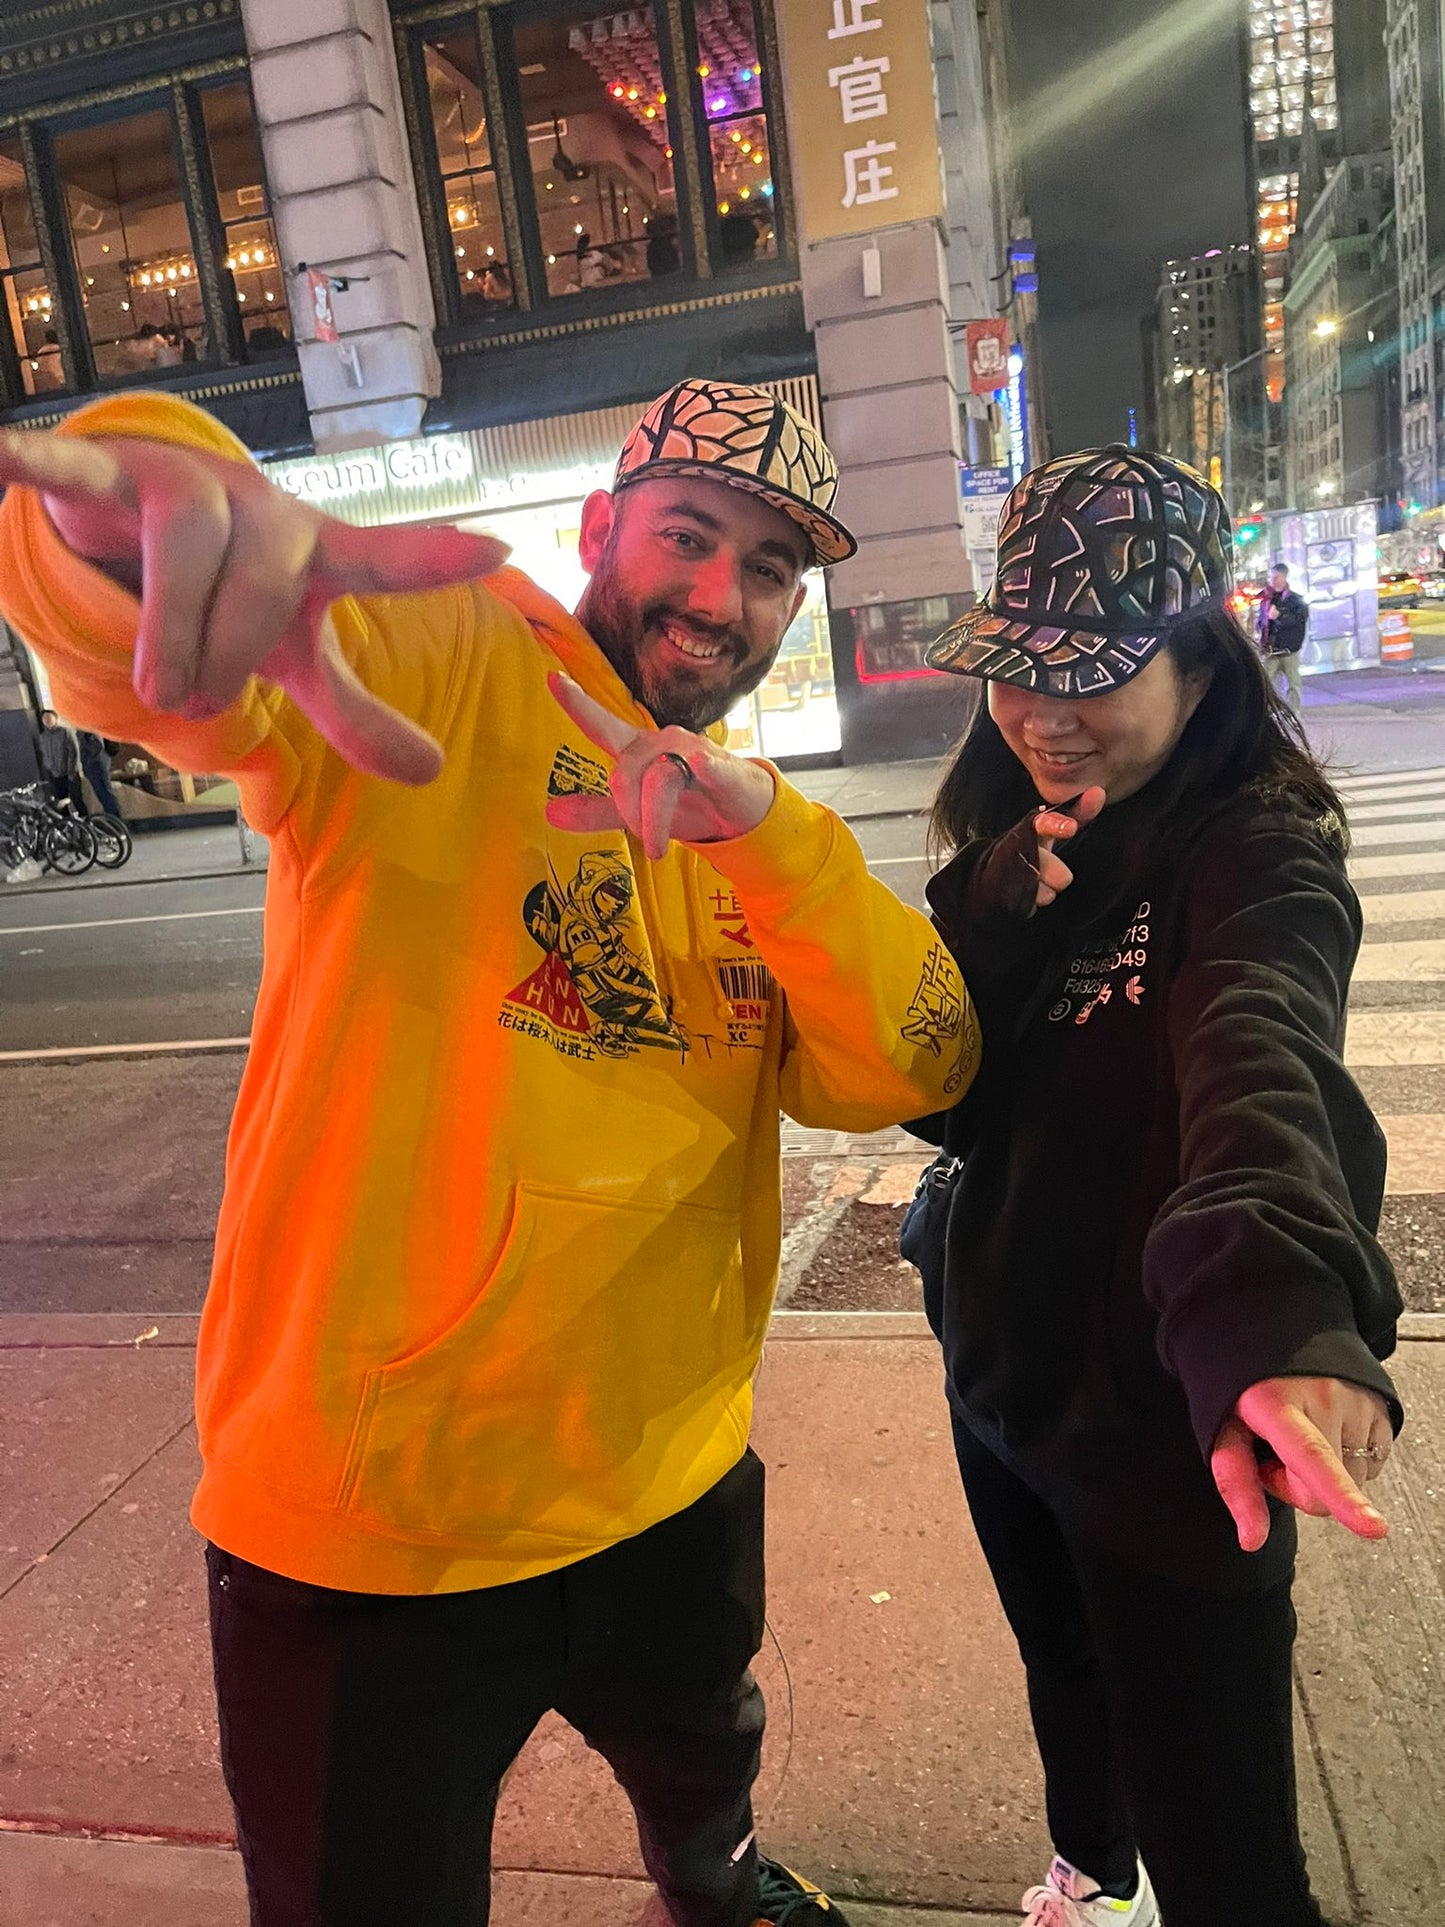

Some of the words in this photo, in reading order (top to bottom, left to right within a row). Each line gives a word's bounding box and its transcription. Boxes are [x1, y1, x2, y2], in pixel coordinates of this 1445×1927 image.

[973, 470, 1001, 479] OFFICE
[965, 478, 991, 488] SPACE
[993, 477, 1010, 485] FOR
[977, 486, 999, 494] RENT
[731, 1004, 762, 1020] EN
